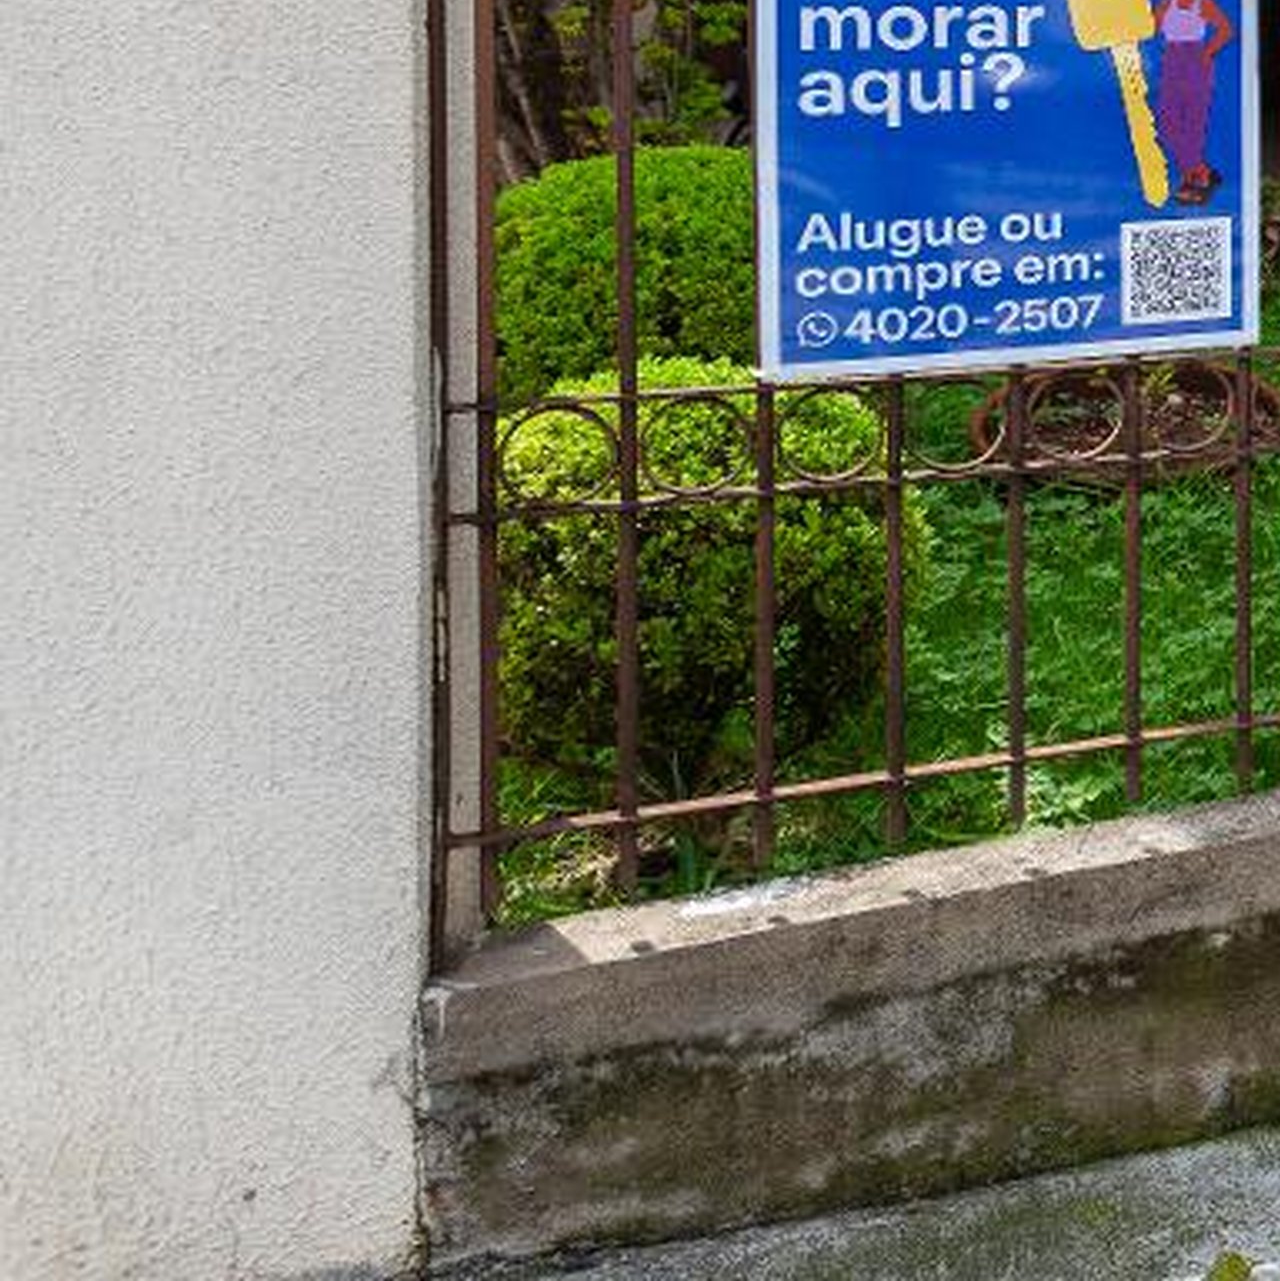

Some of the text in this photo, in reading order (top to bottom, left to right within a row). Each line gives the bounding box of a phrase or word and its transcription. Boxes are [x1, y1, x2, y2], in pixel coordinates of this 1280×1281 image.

[799, 4, 1045, 51] morar
[797, 52, 1026, 128] aqui?
[796, 212, 1063, 258] Alugue ou
[795, 251, 1105, 301] compre em:
[843, 292, 1105, 344] 4020-2507
